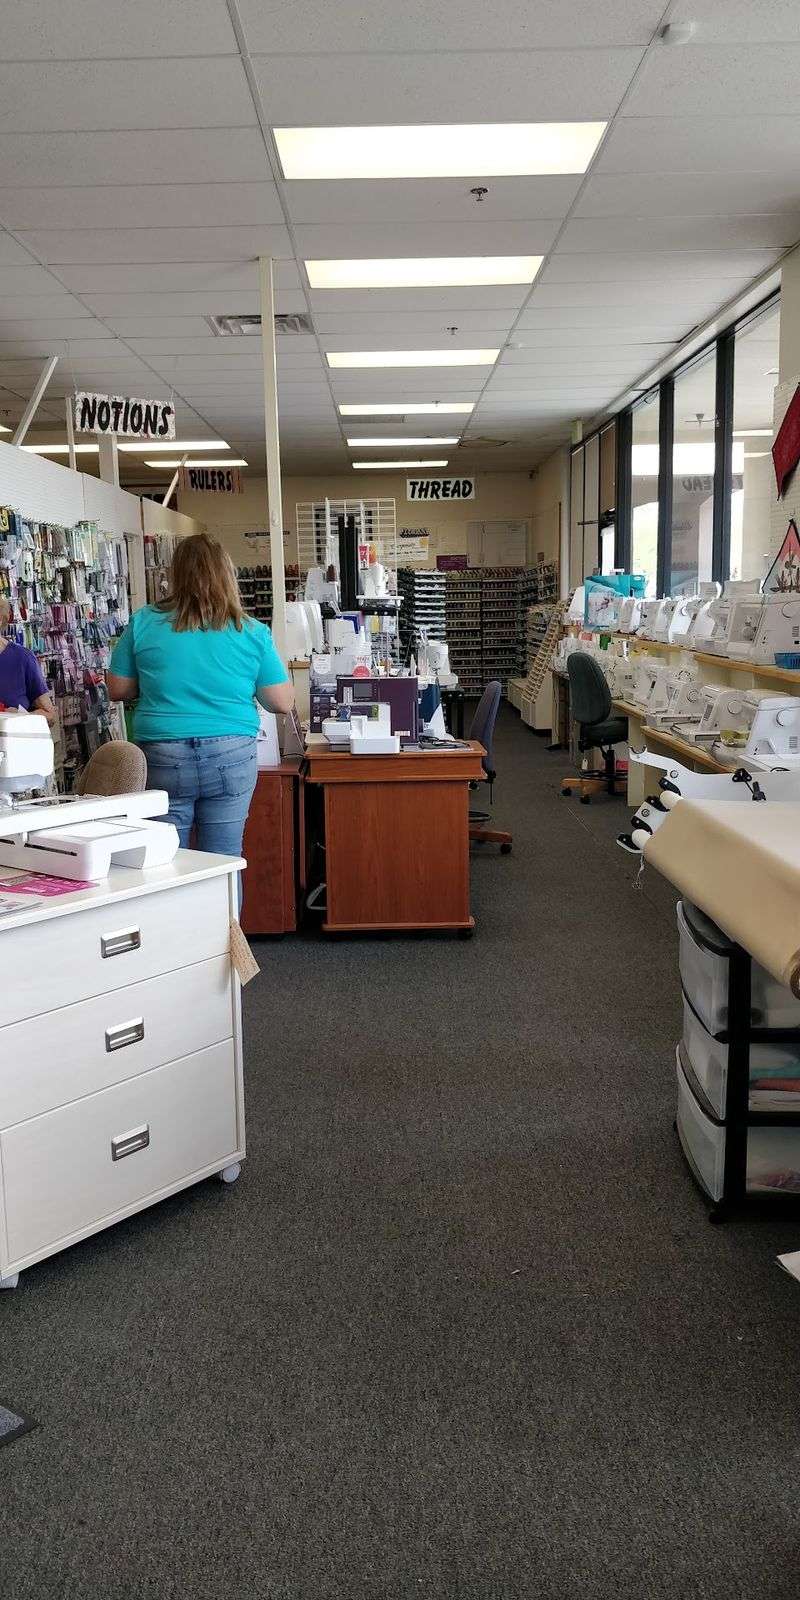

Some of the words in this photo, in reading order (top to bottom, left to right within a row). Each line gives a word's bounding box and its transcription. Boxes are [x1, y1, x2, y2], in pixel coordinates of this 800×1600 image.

[81, 398, 172, 435] NOTIONS
[189, 469, 232, 491] RULERS
[409, 480, 472, 499] THREAD
